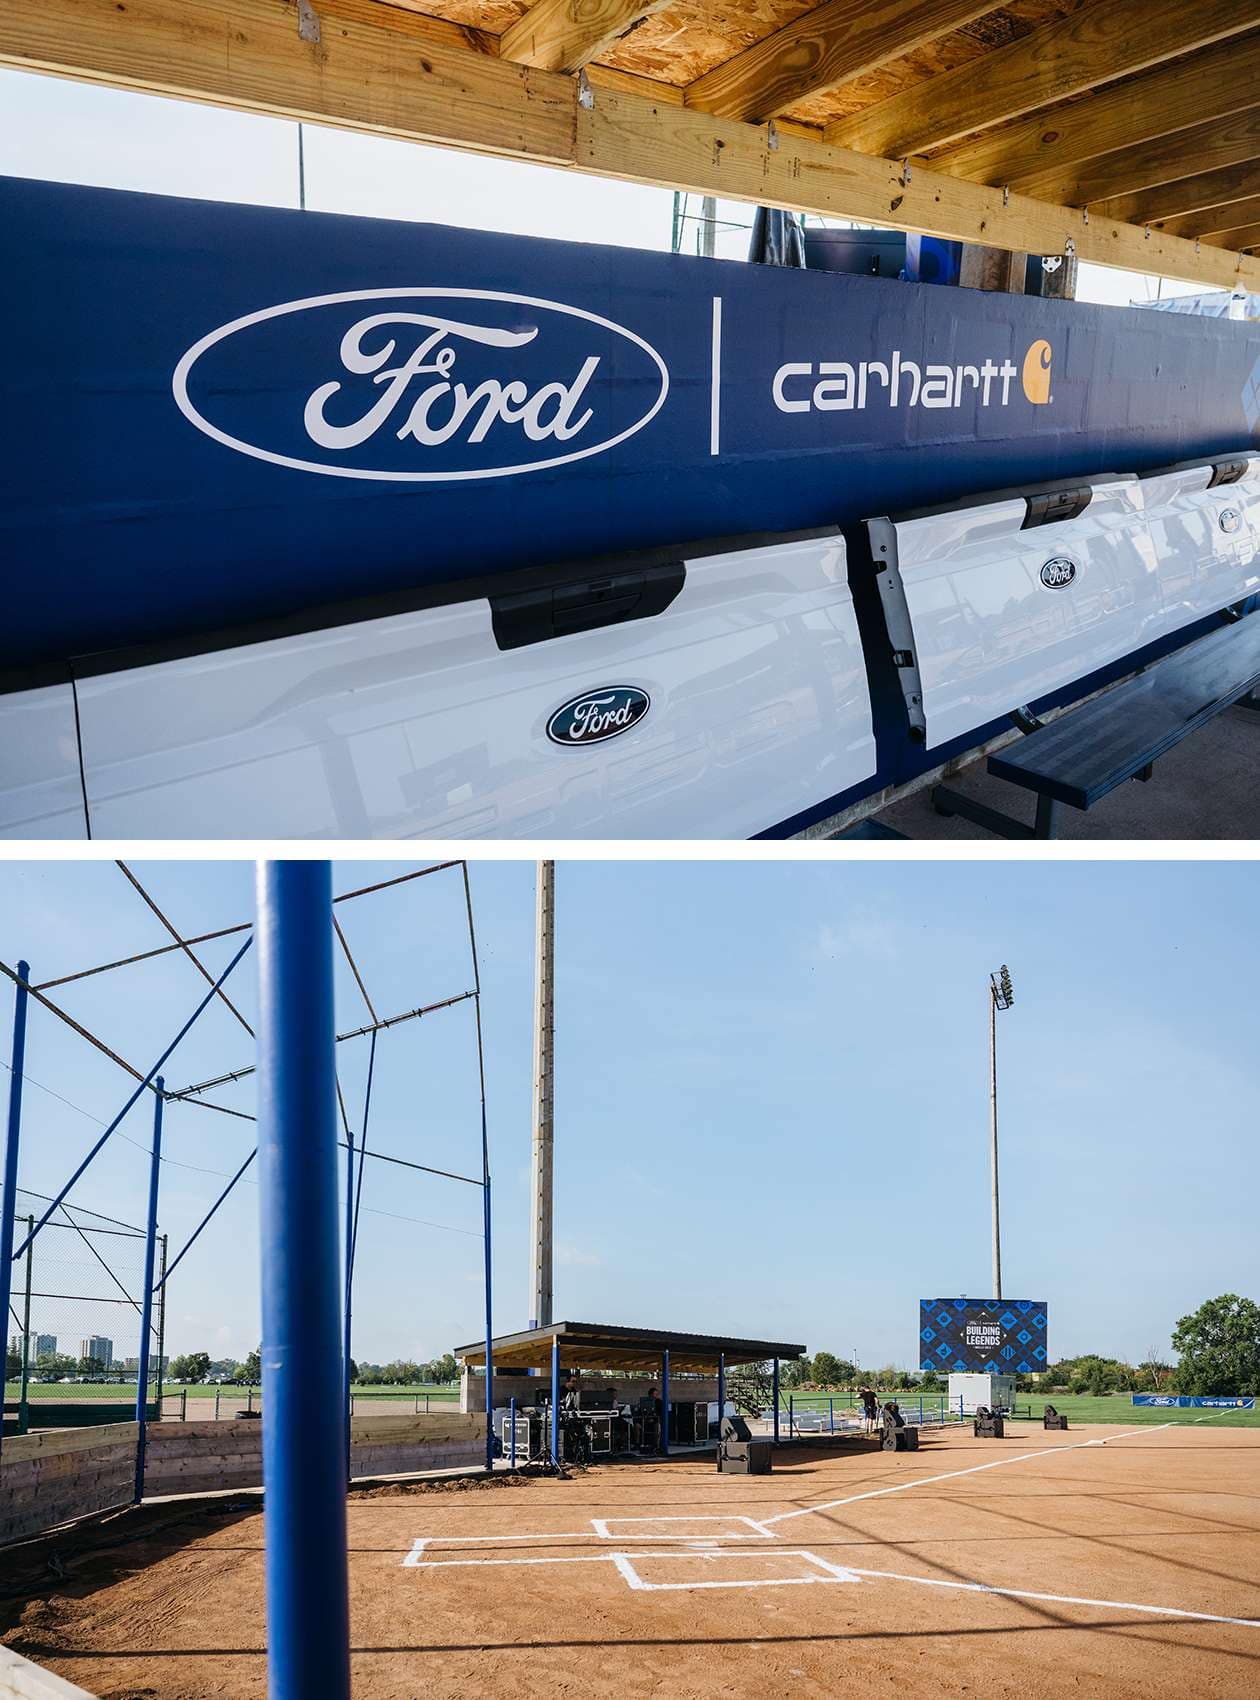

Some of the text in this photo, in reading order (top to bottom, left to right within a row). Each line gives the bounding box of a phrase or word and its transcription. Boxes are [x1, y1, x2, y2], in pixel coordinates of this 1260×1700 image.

[304, 313, 600, 450] Ford
[772, 351, 1018, 413] carhartt
[1048, 560, 1072, 585] Ford
[568, 695, 633, 739] Ford
[966, 1326, 1001, 1336] BUILDING
[966, 1335, 1001, 1345] LEGENDS
